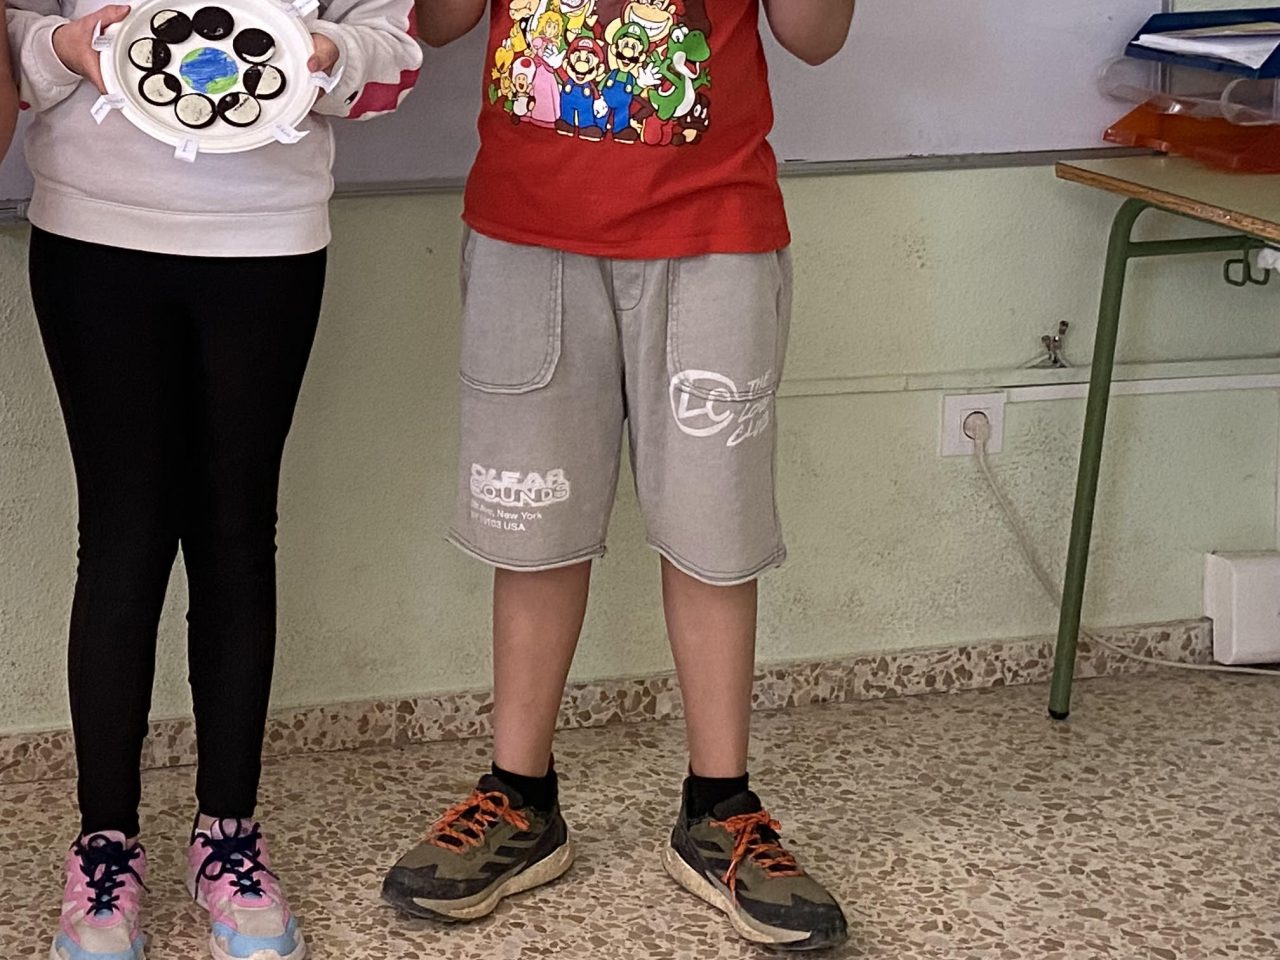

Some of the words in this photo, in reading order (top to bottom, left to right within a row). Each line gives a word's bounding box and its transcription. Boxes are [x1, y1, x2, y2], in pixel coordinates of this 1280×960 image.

[497, 509, 518, 519] New
[521, 511, 543, 520] York
[503, 521, 526, 531] USA
